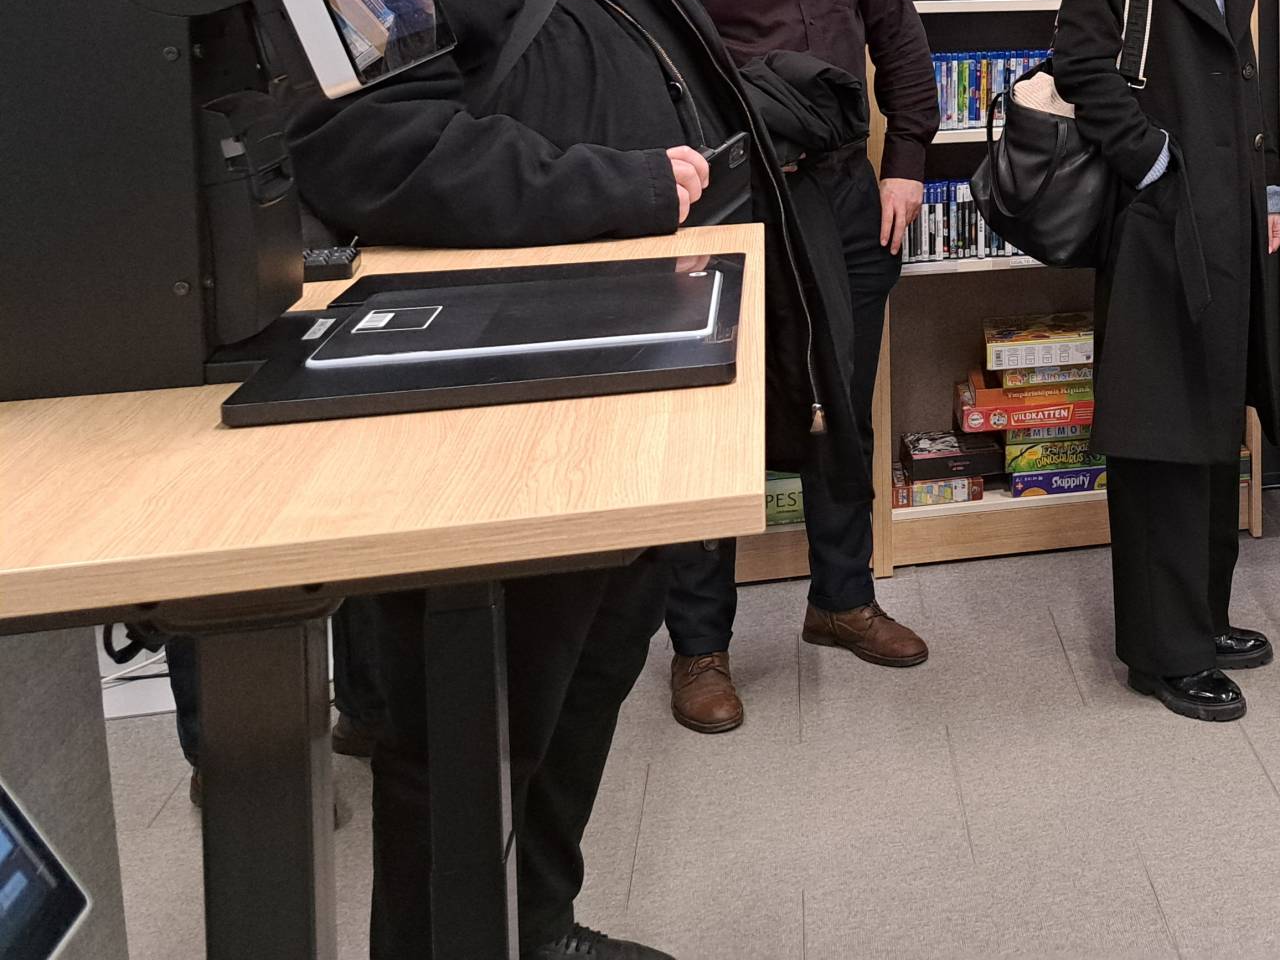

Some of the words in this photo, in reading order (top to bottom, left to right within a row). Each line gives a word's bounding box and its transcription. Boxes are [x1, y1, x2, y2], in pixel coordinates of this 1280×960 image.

[1013, 409, 1068, 422] VILDKATTEN
[1032, 426, 1078, 438] MEMO
[1051, 473, 1090, 489] Skippity
